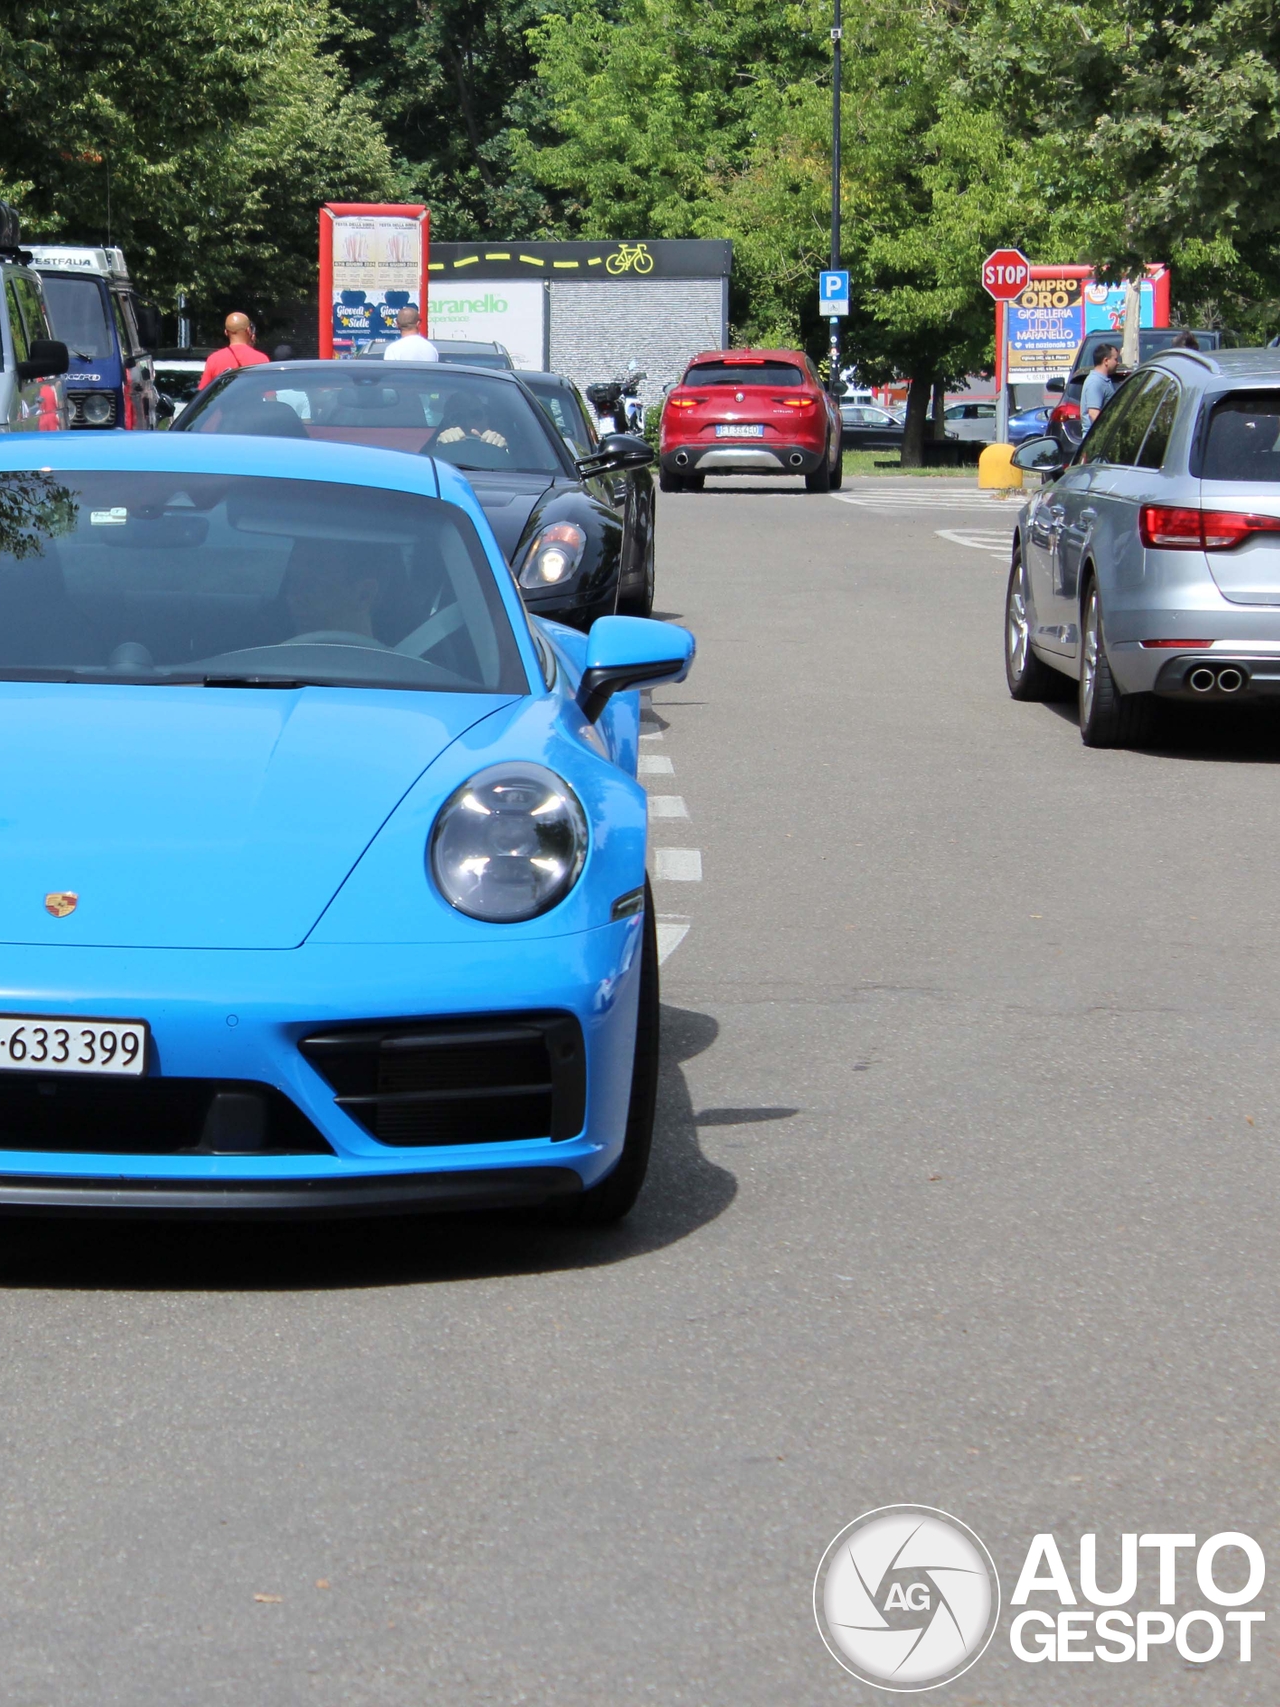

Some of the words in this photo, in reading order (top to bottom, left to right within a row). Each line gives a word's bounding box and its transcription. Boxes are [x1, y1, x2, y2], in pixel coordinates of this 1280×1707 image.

[31, 257, 91, 266] ESTFALIA
[985, 265, 1026, 285] STOP
[826, 276, 842, 297] P
[1023, 279, 1077, 292] OMPRO
[428, 294, 508, 313] aranello
[1021, 292, 1068, 308] ORO
[1018, 309, 1073, 319] GIOIELLERIA
[1028, 318, 1063, 331] LIDDI
[1016, 331, 1074, 340] MARANELLO
